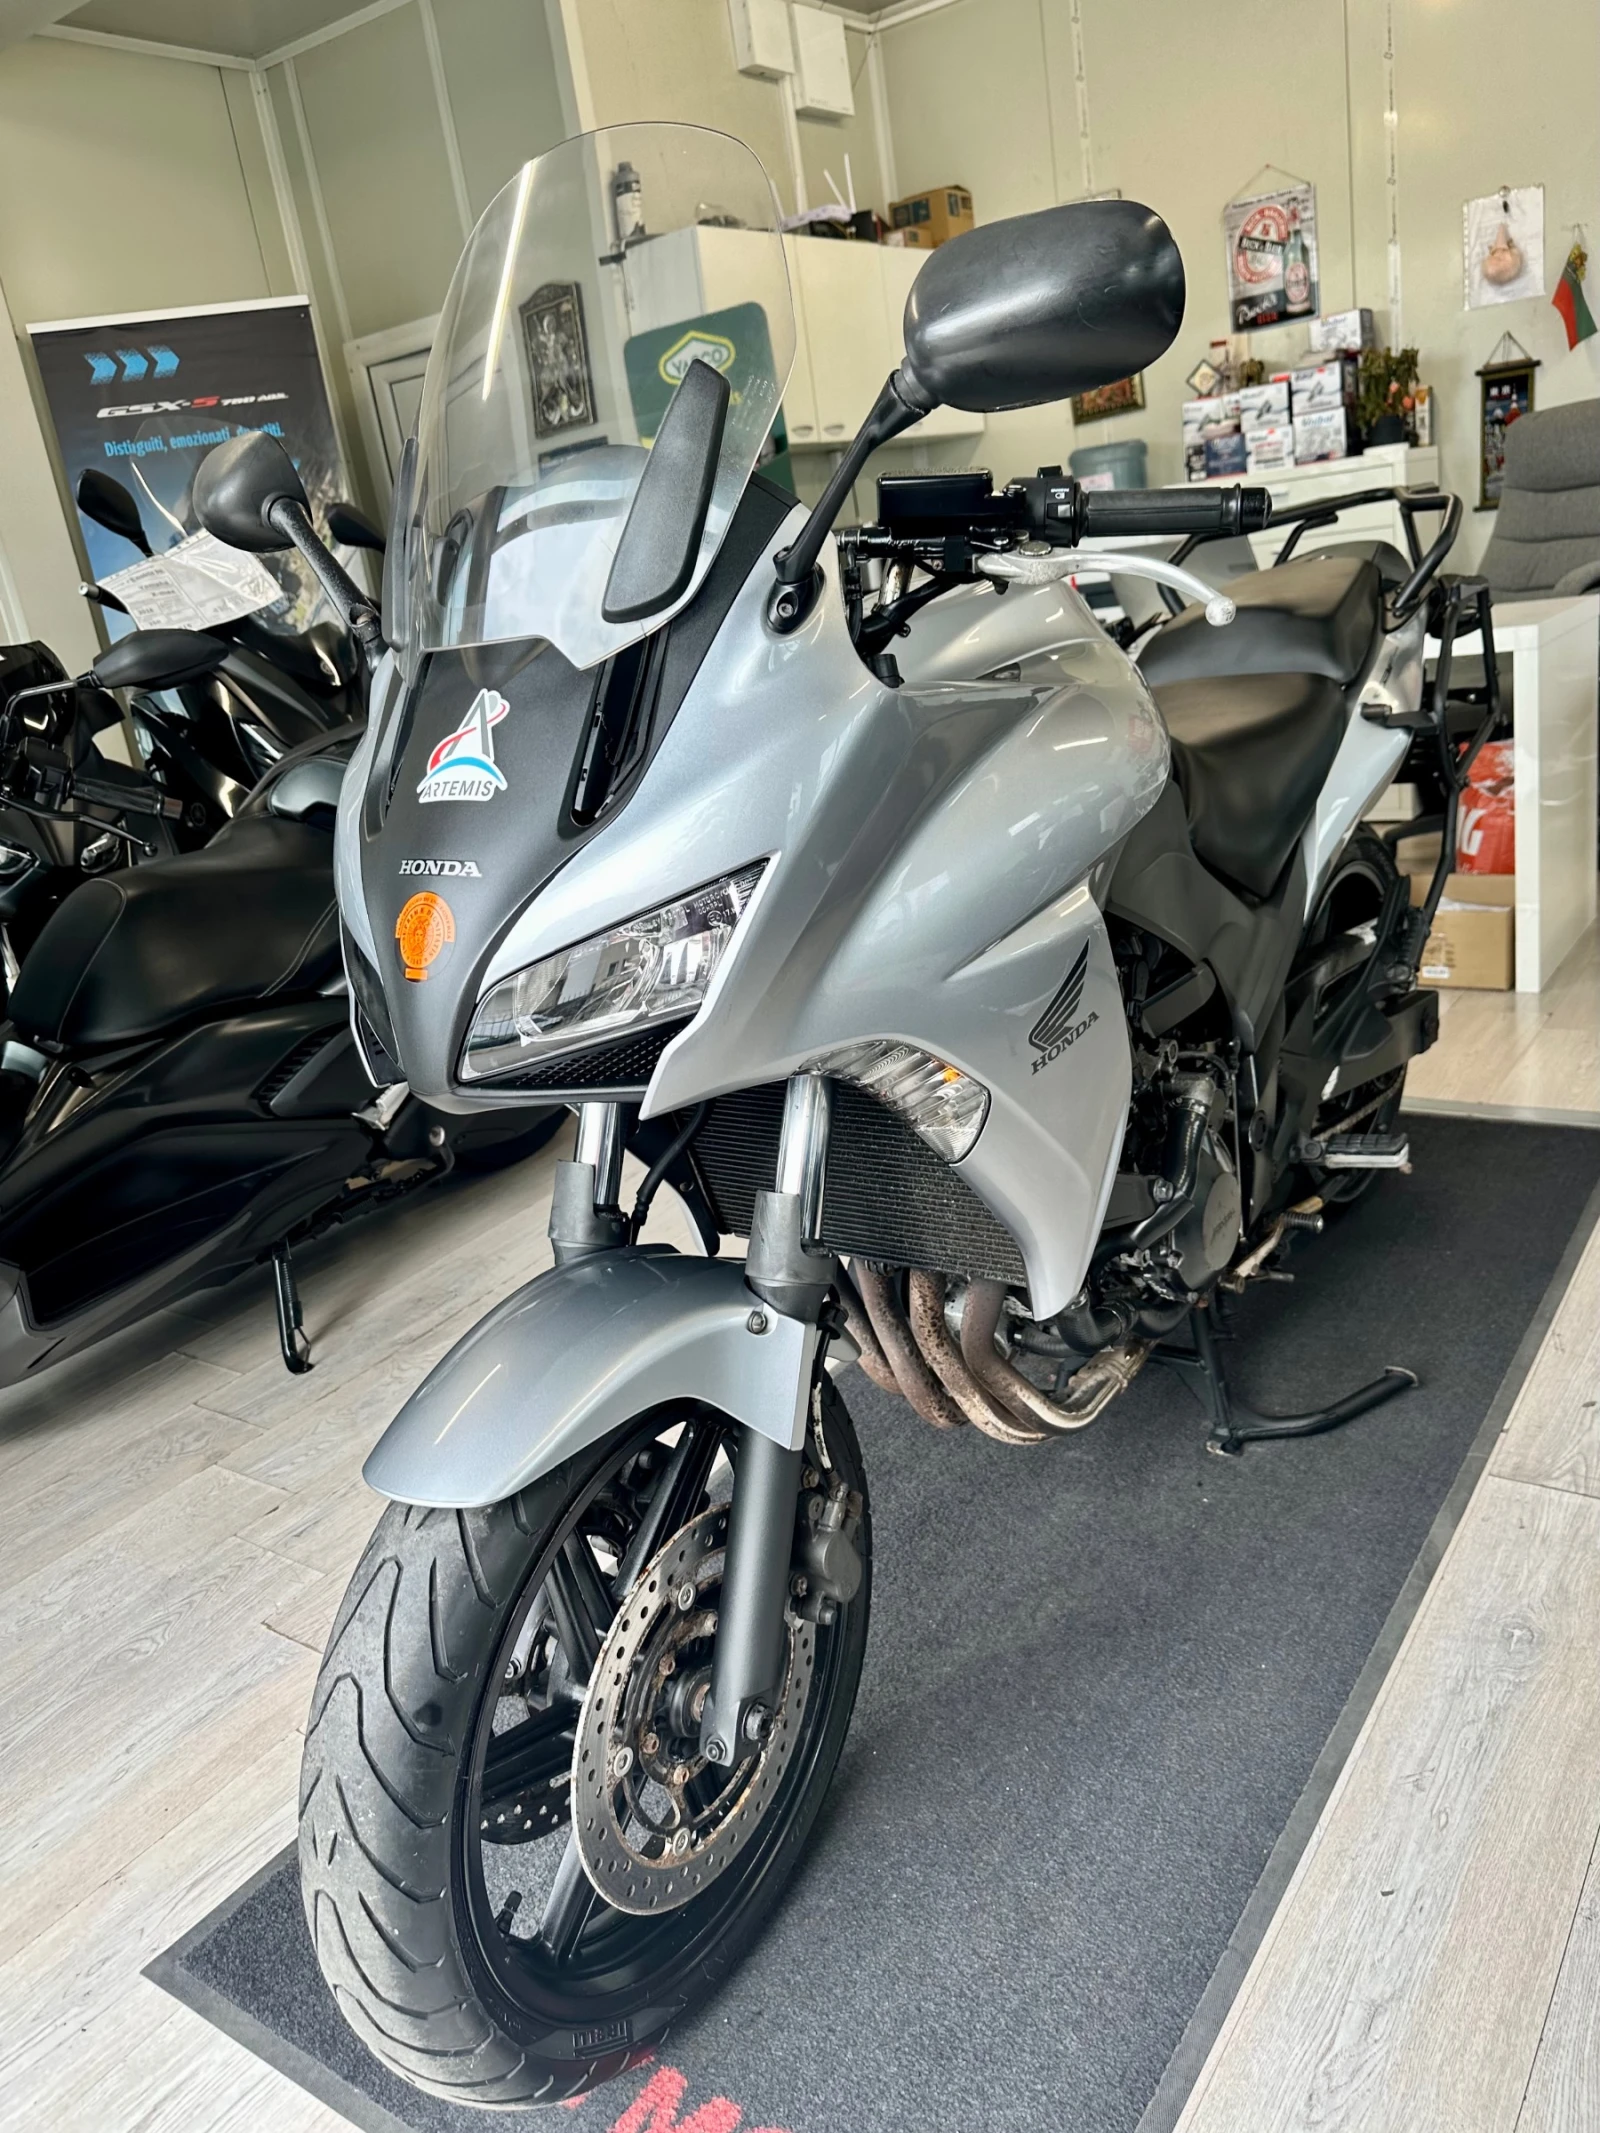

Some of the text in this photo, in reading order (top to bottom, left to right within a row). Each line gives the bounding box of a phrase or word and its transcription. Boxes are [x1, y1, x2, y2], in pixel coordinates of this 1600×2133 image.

[96, 396, 220, 418] GSX-S
[423, 780, 493, 799] ARTEMIS
[399, 859, 482, 878] HONDA
[1031, 1011, 1100, 1076] HONDA
